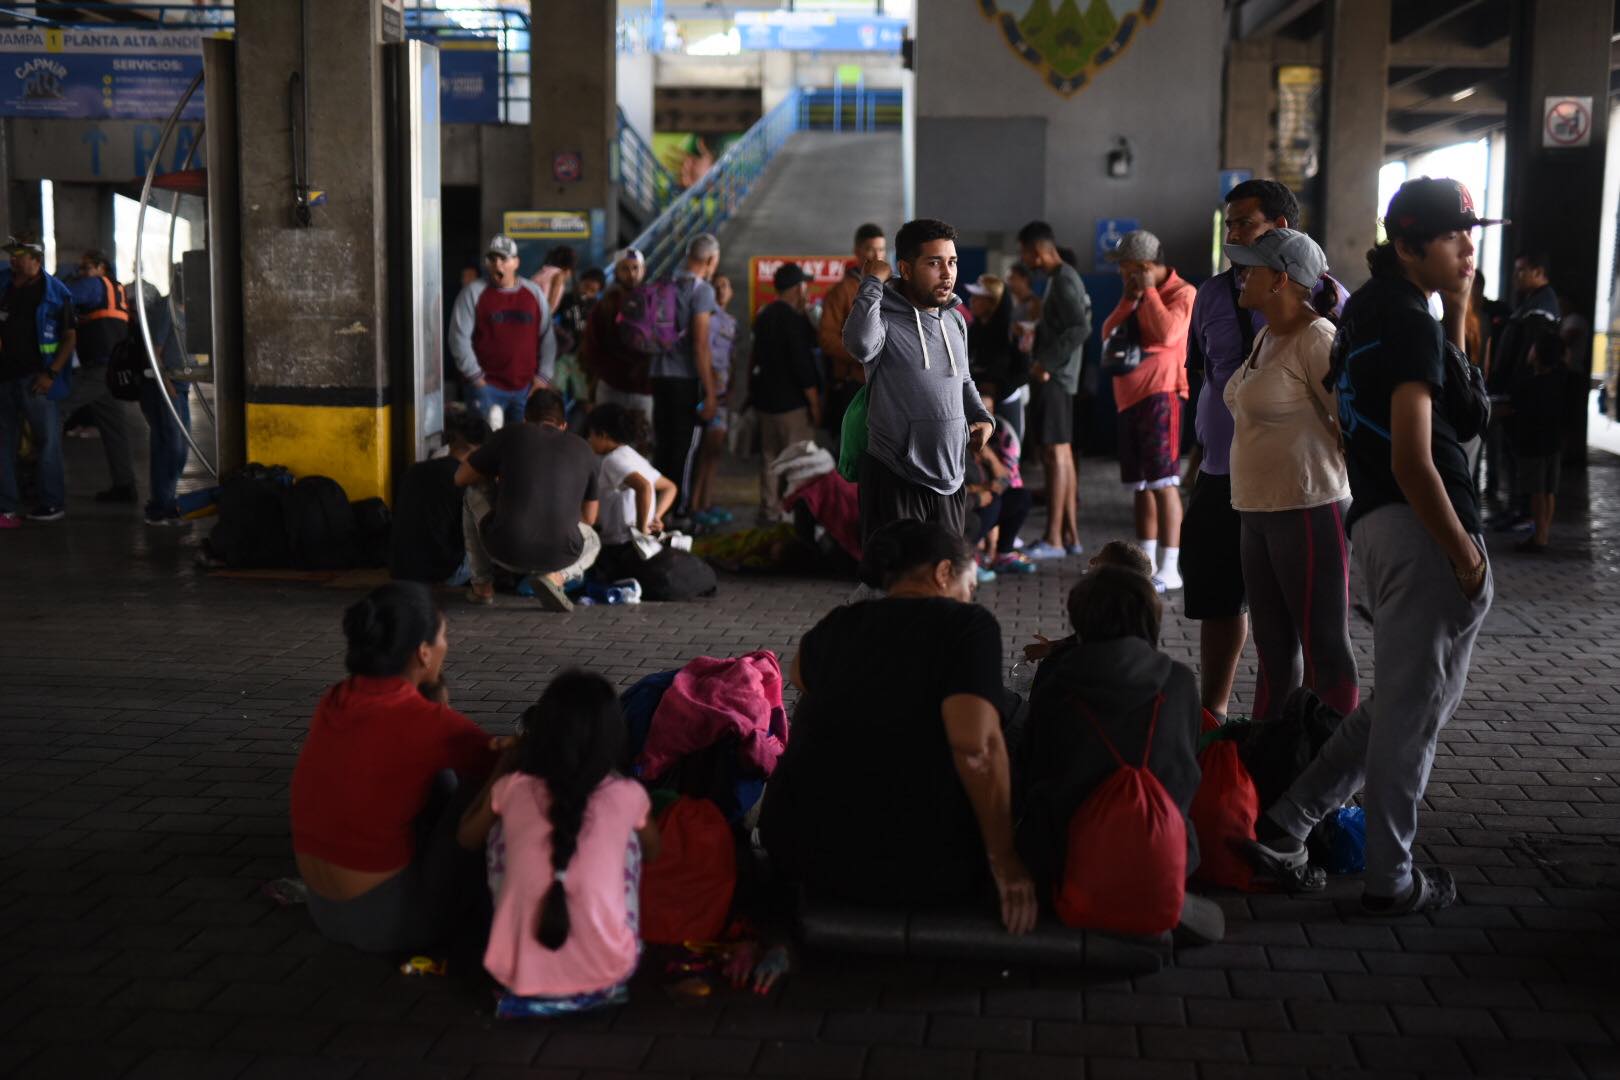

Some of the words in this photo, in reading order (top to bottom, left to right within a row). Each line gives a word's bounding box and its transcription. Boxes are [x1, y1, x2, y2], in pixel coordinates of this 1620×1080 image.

[63, 34, 120, 47] PLANTA
[123, 35, 157, 47] ALTA
[795, 260, 825, 282] AY
